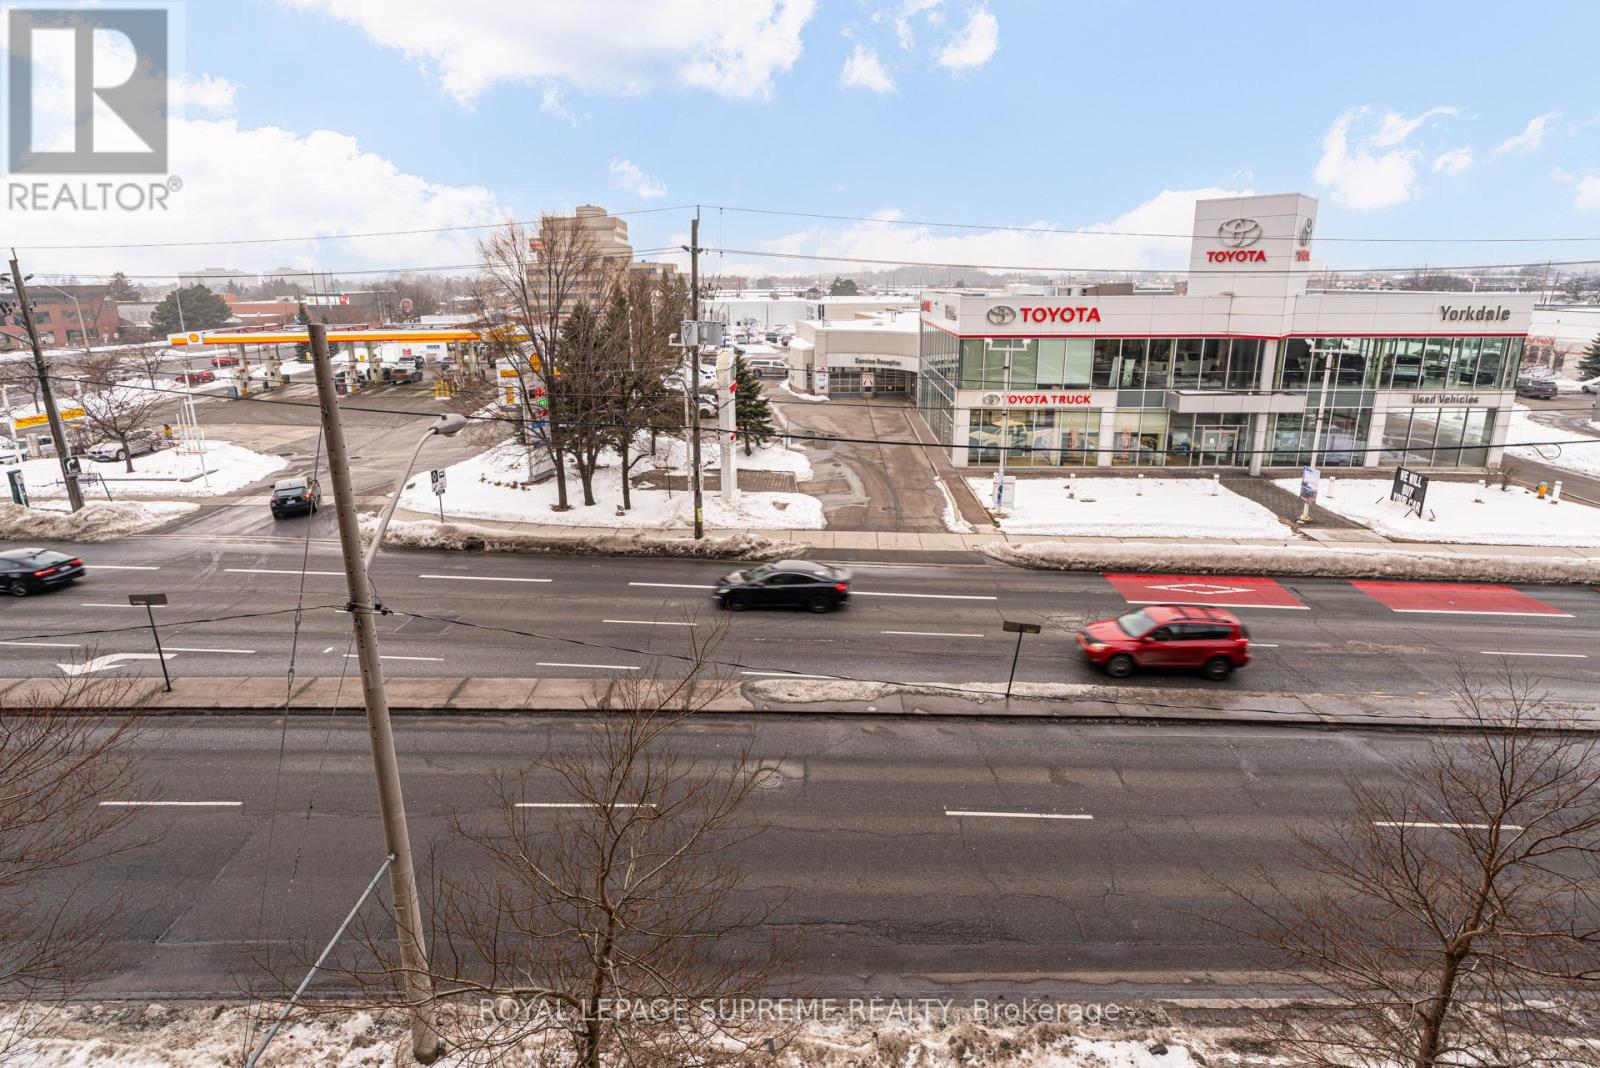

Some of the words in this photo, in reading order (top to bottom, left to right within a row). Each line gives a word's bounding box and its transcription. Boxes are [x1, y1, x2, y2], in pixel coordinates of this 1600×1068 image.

[1207, 250, 1267, 263] TOYOTA
[1020, 307, 1101, 323] TOYOTA
[1440, 305, 1511, 321] Yorkdale
[855, 357, 876, 365] Service
[877, 358, 902, 367] Reception
[1003, 395, 1048, 404] OYOTA
[1051, 395, 1091, 404] TRUCK
[1412, 393, 1436, 404] Used
[1439, 393, 1479, 404] Vehicles
[1400, 470, 1409, 482] WE
[1409, 473, 1422, 488] WILL
[1402, 484, 1415, 498] BUY
[1408, 498, 1421, 514] CAR
